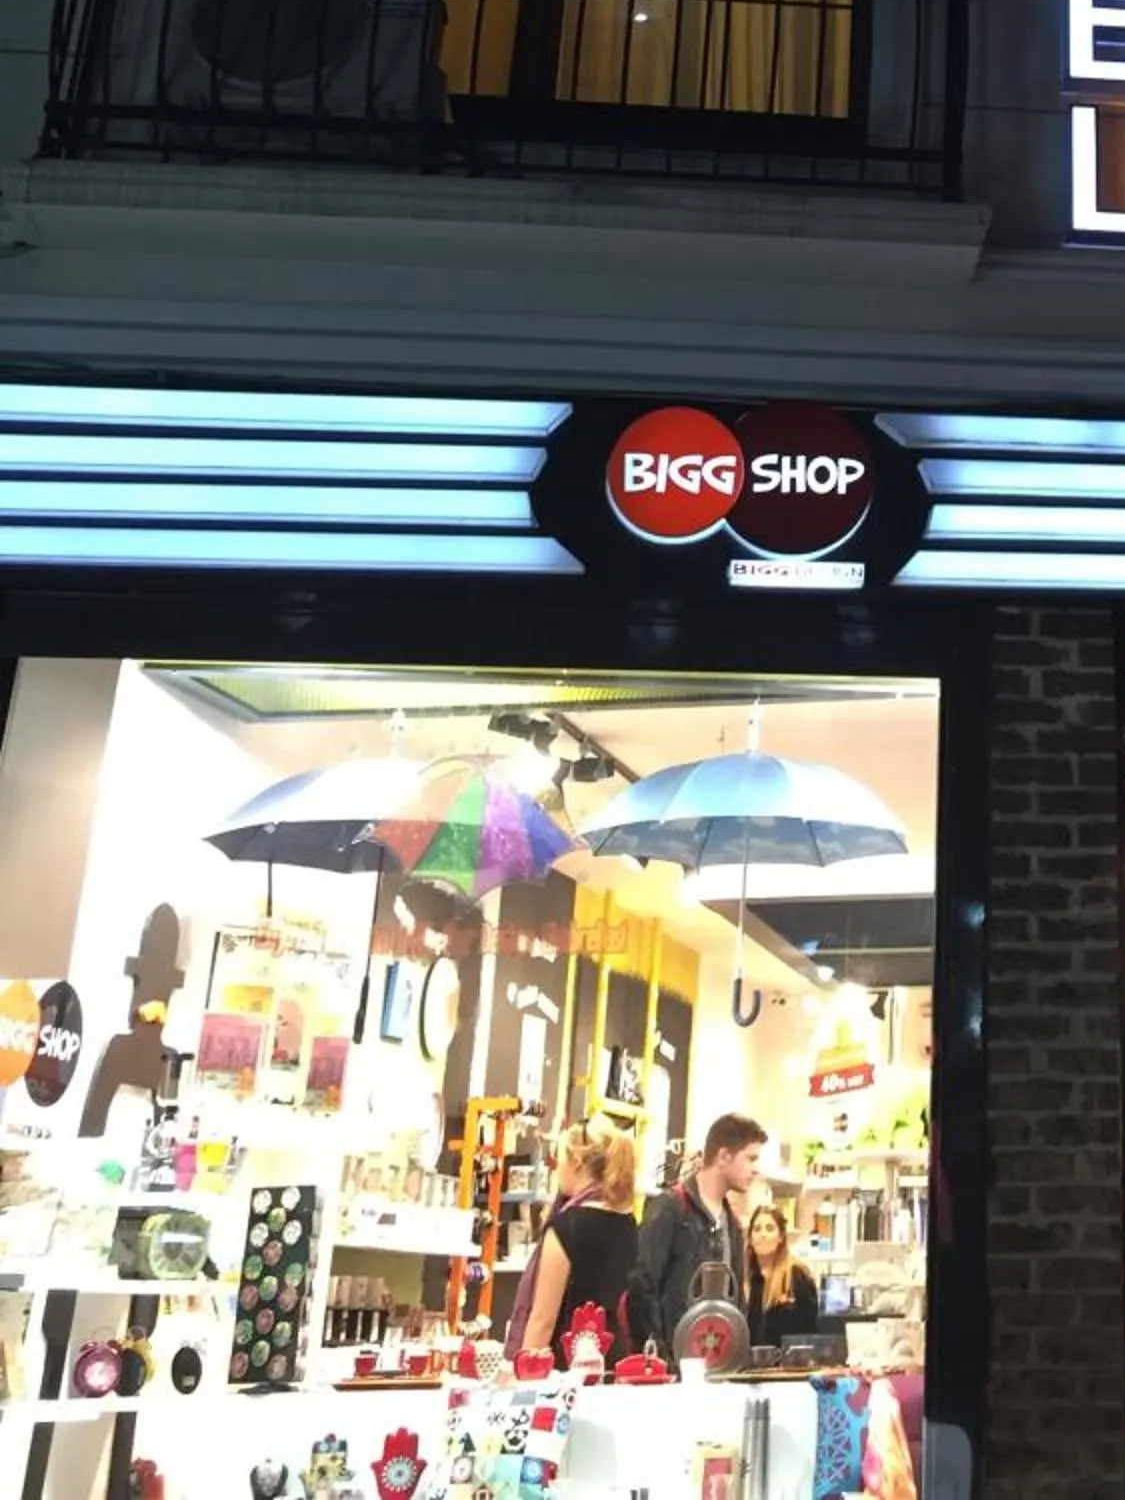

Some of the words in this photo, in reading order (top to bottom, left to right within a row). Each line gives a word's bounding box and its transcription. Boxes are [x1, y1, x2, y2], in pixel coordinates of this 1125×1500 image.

[623, 452, 737, 495] BIGG
[750, 453, 866, 495] SHOP
[38, 1024, 80, 1061] SHOP
